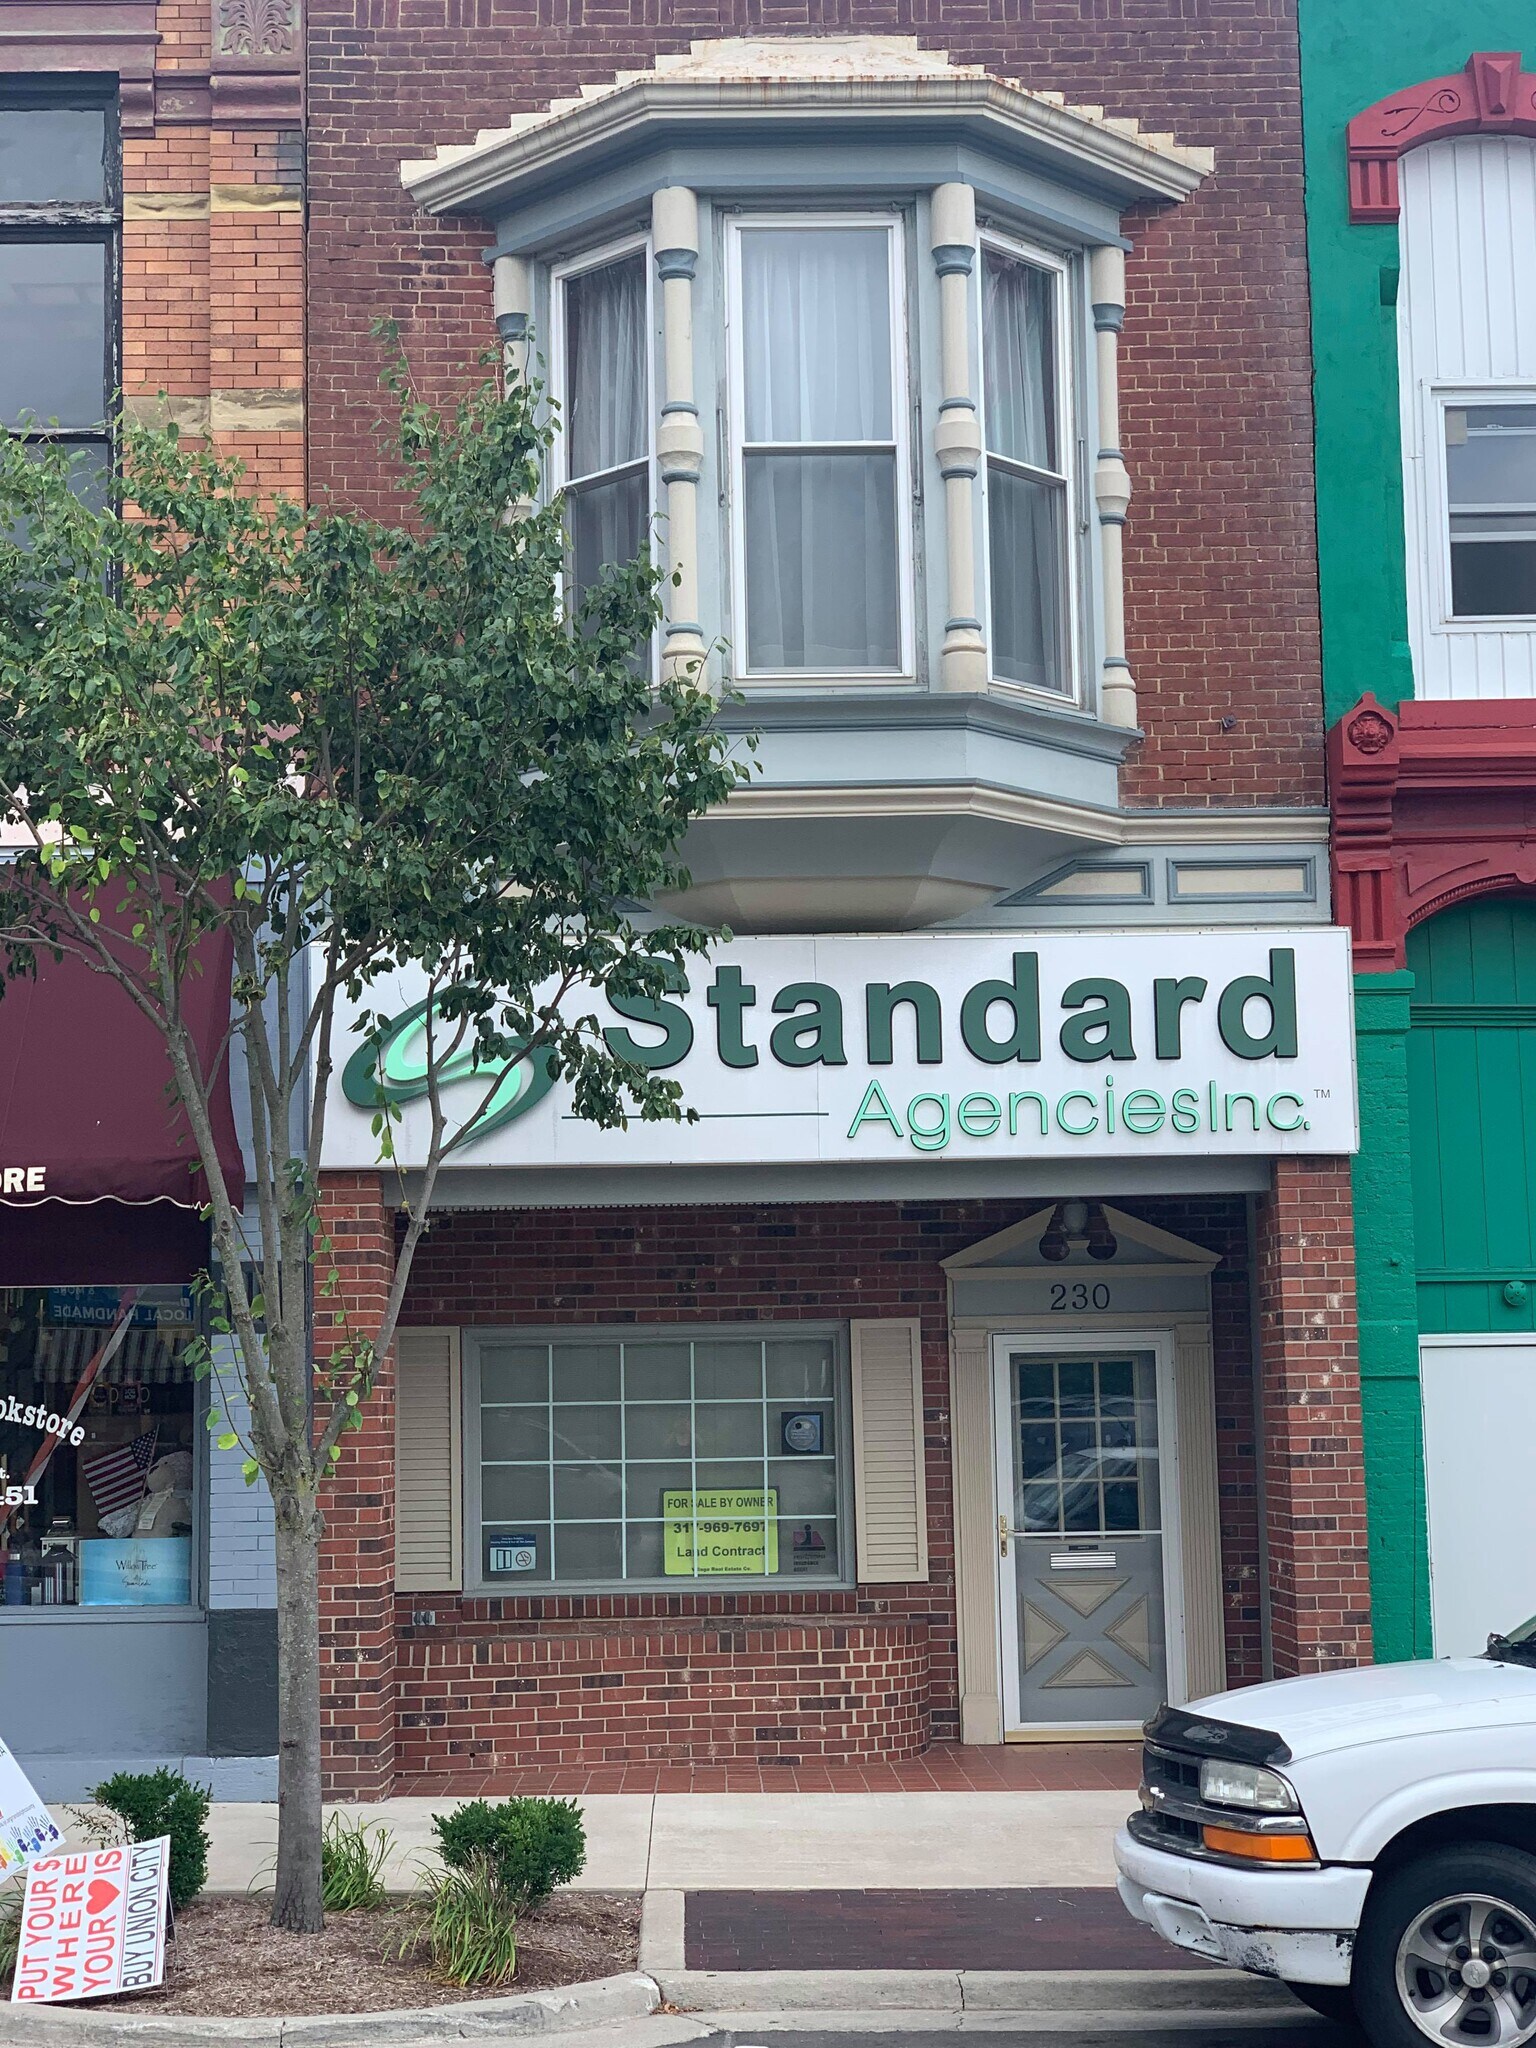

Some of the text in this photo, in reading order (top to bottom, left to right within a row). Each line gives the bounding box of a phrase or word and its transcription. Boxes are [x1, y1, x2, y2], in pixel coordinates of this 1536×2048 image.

[602, 947, 1300, 1070] Standard
[0, 1166, 46, 1194] RE
[1050, 1283, 1111, 1311] 230
[667, 1498, 688, 1508] FOR
[720, 1497, 733, 1508] BY
[25, 1878, 59, 1947] YOUR
[51, 1855, 88, 1997] WHERE
[82, 1850, 123, 1994] YOUR IS
[122, 1844, 161, 1988] BUY UNION CITY
[18, 1955, 50, 2000] PUT
